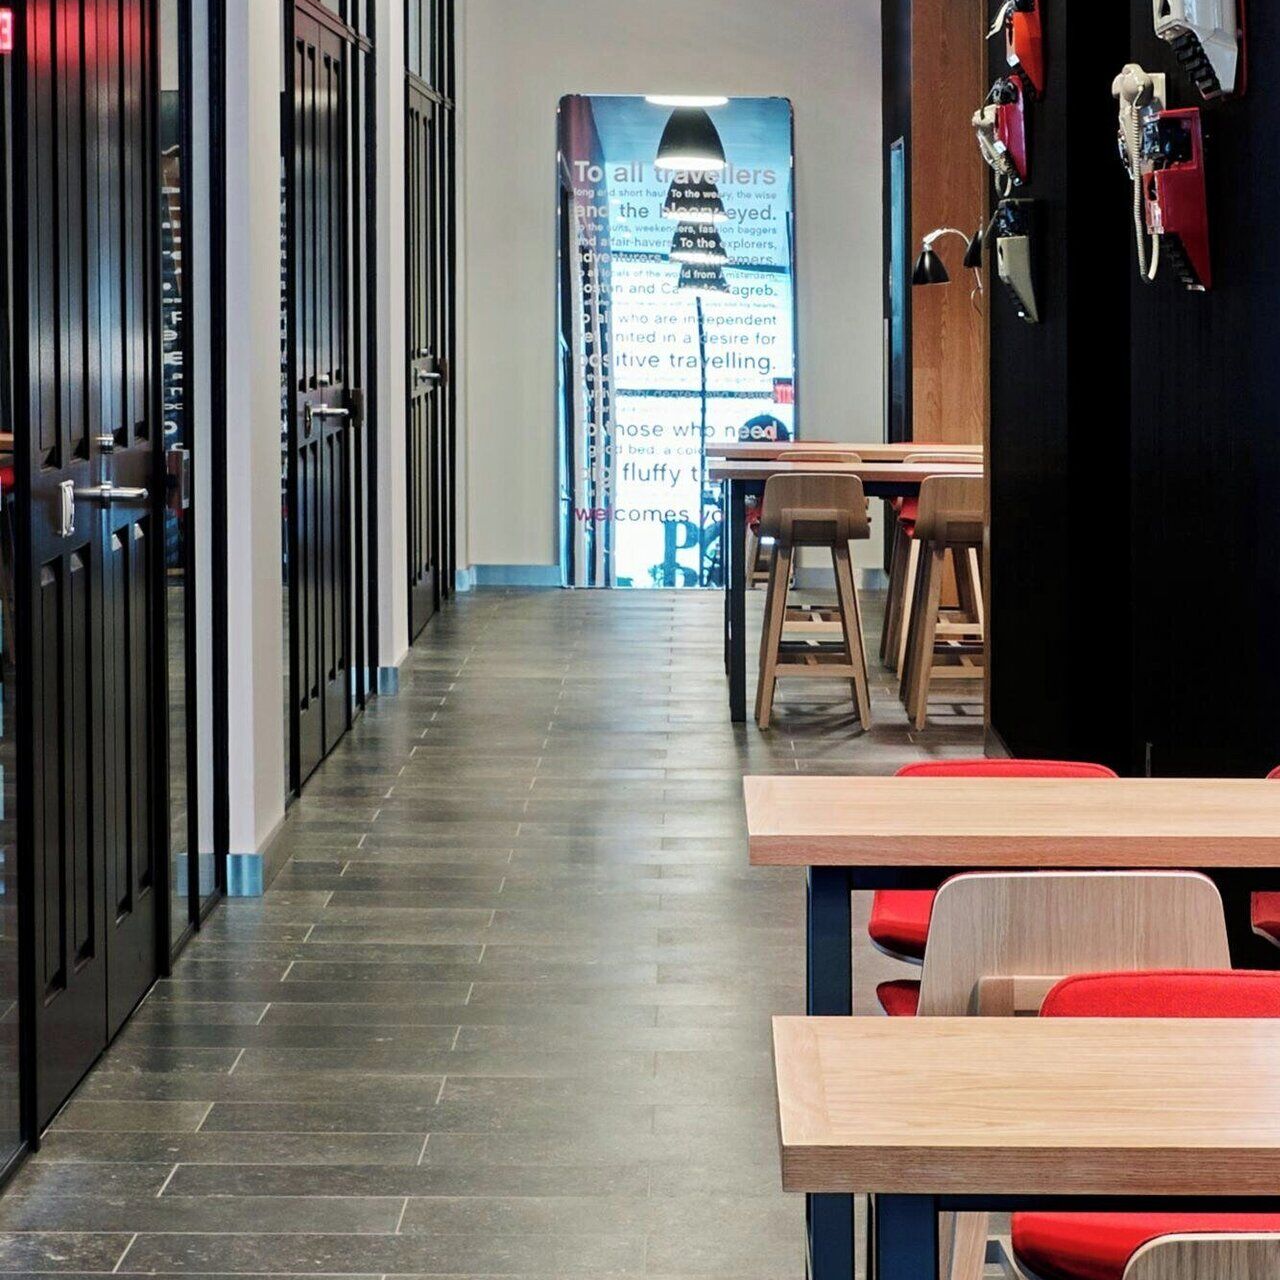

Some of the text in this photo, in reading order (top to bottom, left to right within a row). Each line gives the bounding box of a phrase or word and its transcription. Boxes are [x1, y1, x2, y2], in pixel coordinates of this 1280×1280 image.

[574, 160, 777, 186] To all travellers
[619, 188, 642, 198] short
[671, 188, 682, 198] To
[684, 188, 701, 198] the
[737, 190, 752, 200] the
[755, 191, 777, 200] wise
[620, 203, 649, 219] the
[737, 226, 777, 237] baggers
[680, 238, 694, 249] To
[696, 238, 716, 249] the
[693, 270, 717, 279] from
[629, 282, 656, 295] and
[618, 312, 649, 325] who
[654, 314, 678, 325] are
[663, 333, 677, 344] in
[683, 334, 692, 344] a
[700, 332, 750, 345] desire
[755, 332, 777, 345] for
[669, 353, 777, 376] travelling.
[672, 421, 778, 442] who need
[623, 461, 681, 488] fluffy
[575, 506, 690, 523] welcomes
